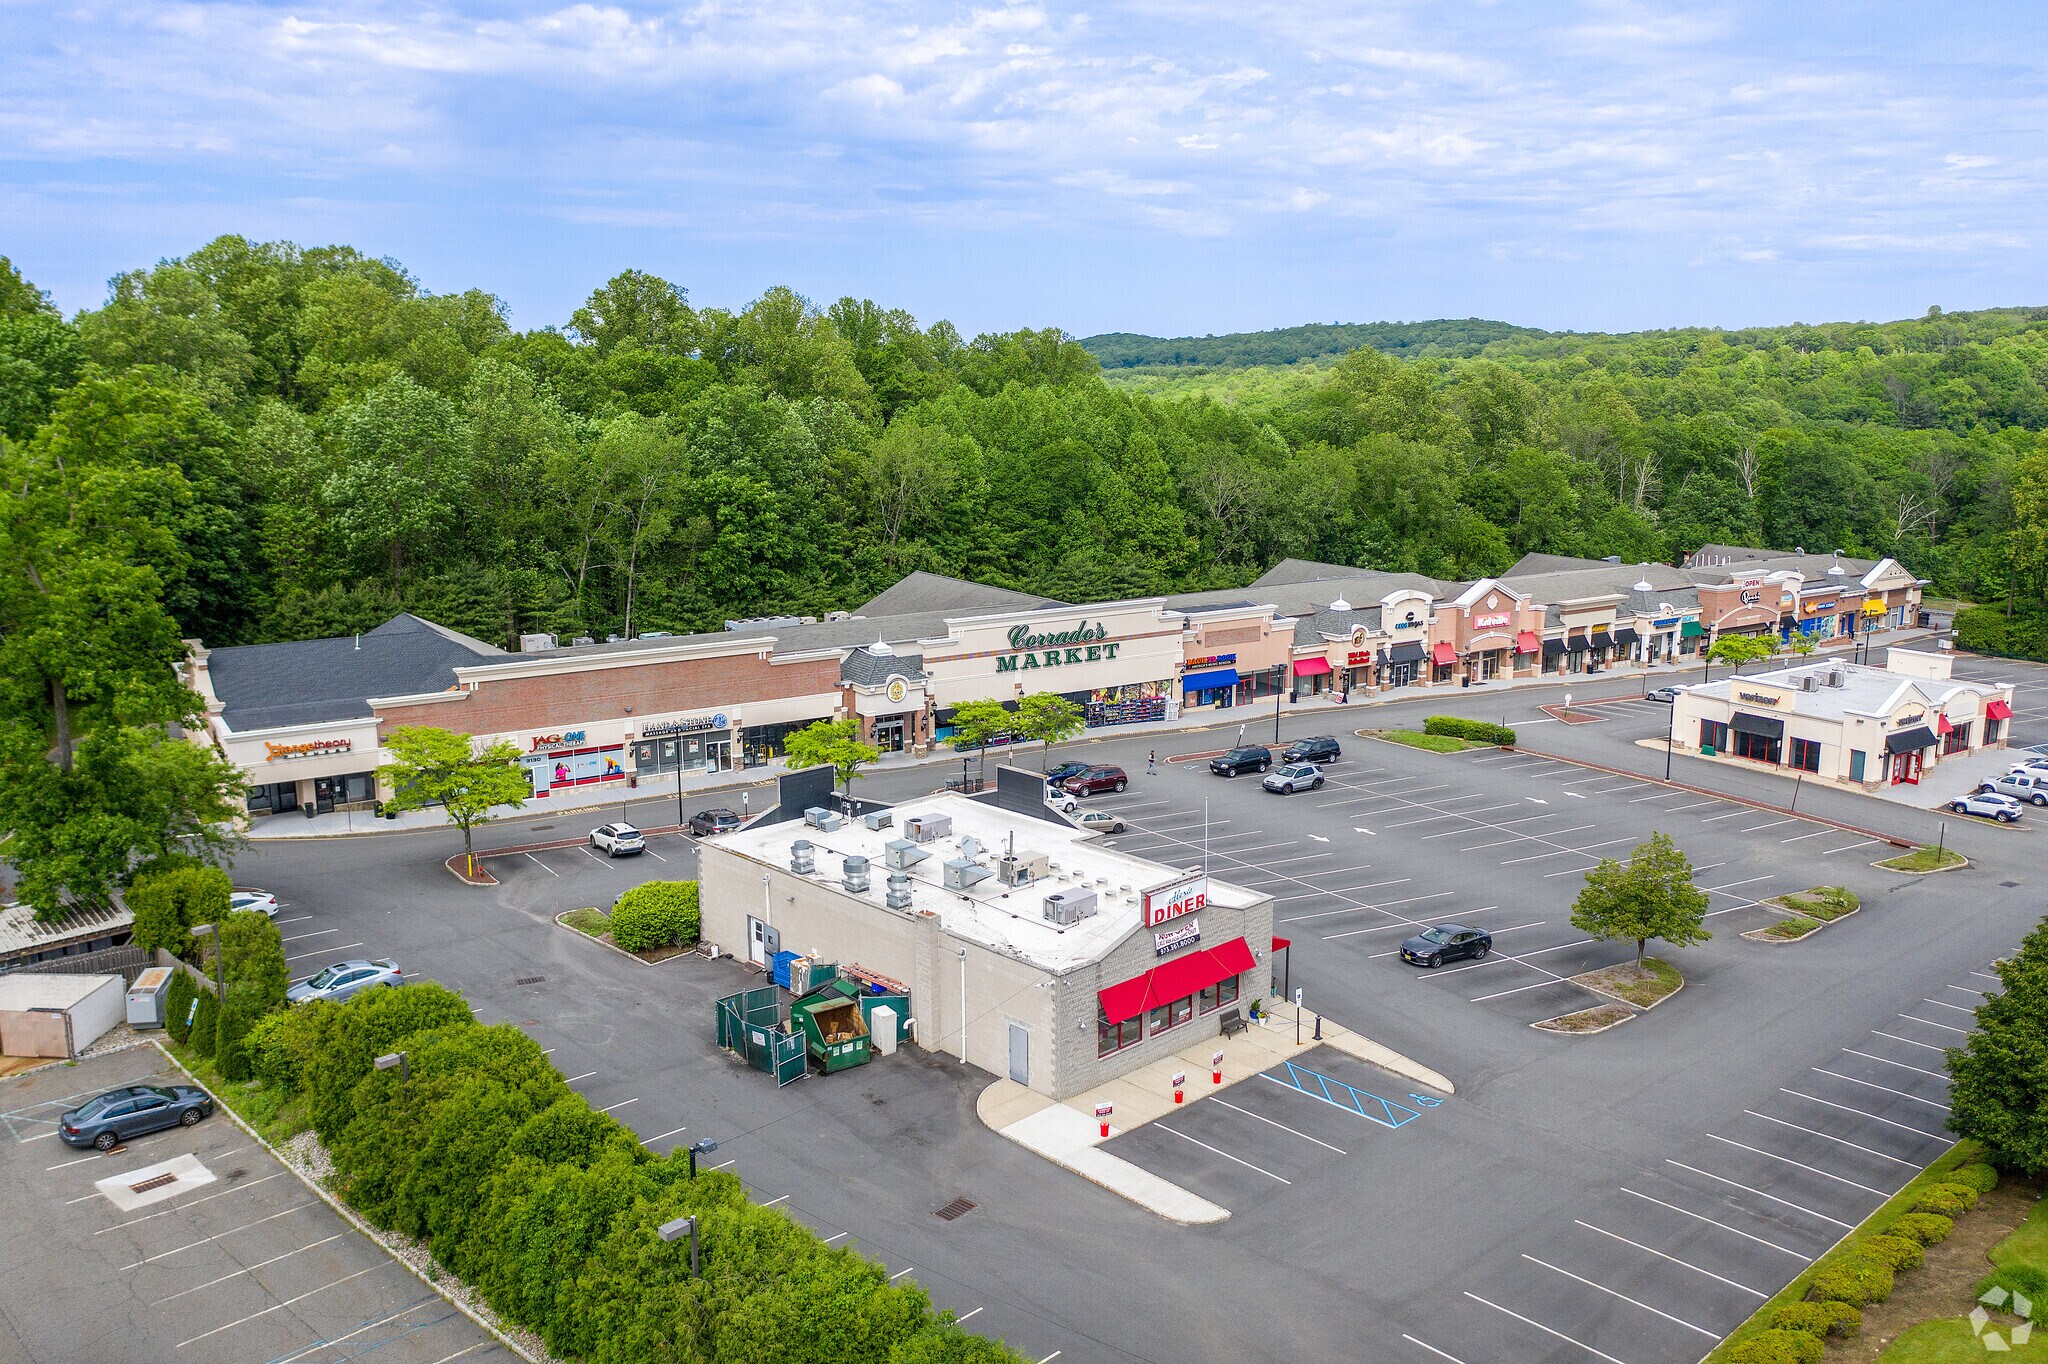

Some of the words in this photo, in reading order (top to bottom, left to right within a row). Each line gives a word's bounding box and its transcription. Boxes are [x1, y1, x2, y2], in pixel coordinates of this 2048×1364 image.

[1745, 579, 1759, 587] OPEN
[1478, 615, 1509, 627] Kidville
[1007, 620, 1108, 650] Corrado's
[996, 643, 1120, 673] MARKET
[1739, 692, 1777, 706] verizon
[680, 716, 713, 728] STONE
[1154, 894, 1206, 923] DINER
